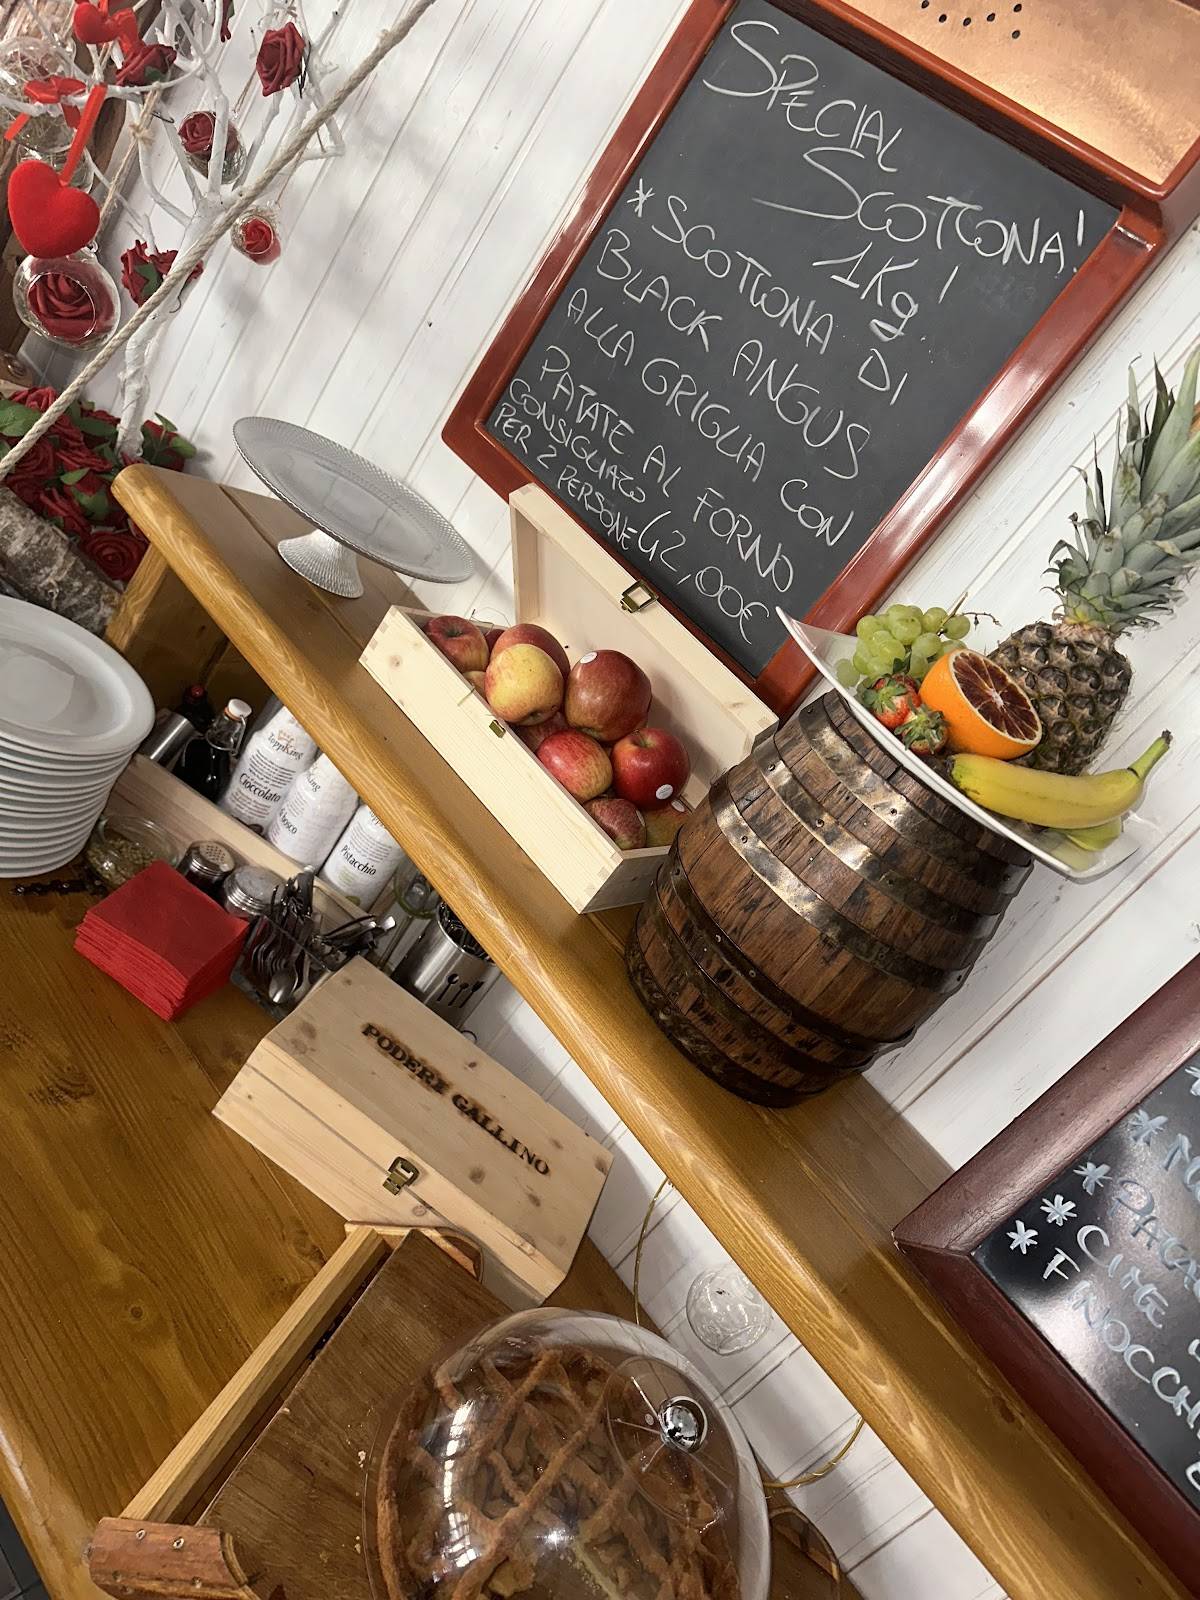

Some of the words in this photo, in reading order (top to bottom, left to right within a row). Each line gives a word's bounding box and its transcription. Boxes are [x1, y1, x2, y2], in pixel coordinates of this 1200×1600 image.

[703, 21, 902, 172] SPECIAL
[568, 288, 634, 366] ALLA
[642, 358, 765, 482] GRIGLIA
[780, 479, 854, 546] CON
[597, 229, 722, 352] BLACK
[733, 340, 870, 479] ANGUS
[858, 348, 907, 405] DI
[495, 403, 531, 454] PER
[537, 445, 557, 469] 2
[558, 465, 637, 550] PERSONE
[510, 378, 646, 503] CONSIGLIATO
[540, 345, 635, 454] PATATE
[643, 445, 682, 497] AL
[693, 488, 793, 592] FORNO
[239, 772, 281, 803] Cioccolato
[341, 845, 377, 877] Pistacchio
[362, 1023, 449, 1095] PODERE
[452, 1094, 549, 1176] GALLINO
[1042, 1247, 1200, 1439] FINOCCH
